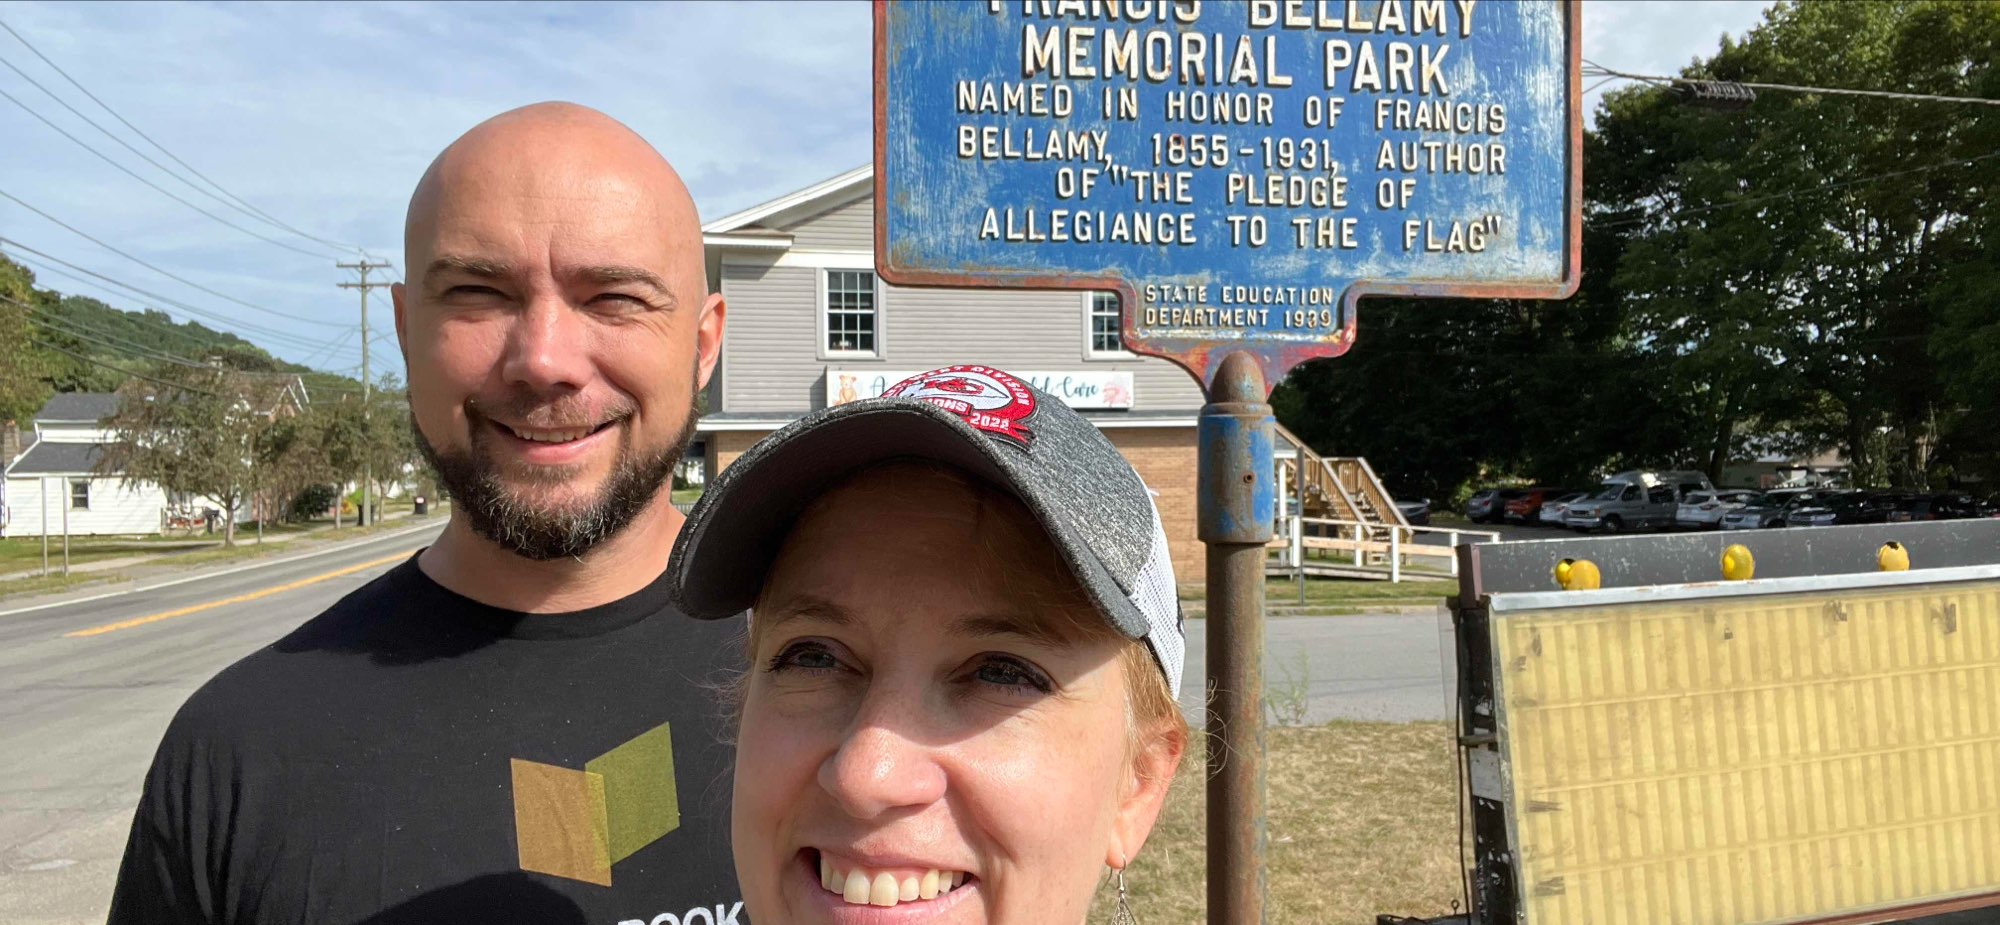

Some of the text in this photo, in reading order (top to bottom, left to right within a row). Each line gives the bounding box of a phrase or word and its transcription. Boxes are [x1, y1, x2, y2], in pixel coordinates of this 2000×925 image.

[1024, 24, 1450, 94] MEMORIAL PARK
[958, 80, 1506, 134] NAMED IN HONOR OF FRANCIS
[958, 125, 1112, 172] BELLAMY,
[1377, 139, 1506, 174] AUTHOR
[1058, 164, 1416, 209] OF "THE PLEDGE OF
[980, 208, 1501, 251] ALLEGIANCE TO THE FLAG"
[1145, 284, 1333, 304] STATE EDUCATION
[1145, 308, 1332, 328] DEPARTMENT 1939
[971, 366, 1030, 406] DIVISION
[1057, 376, 1099, 398] Care
[970, 412, 1009, 430] 2022
